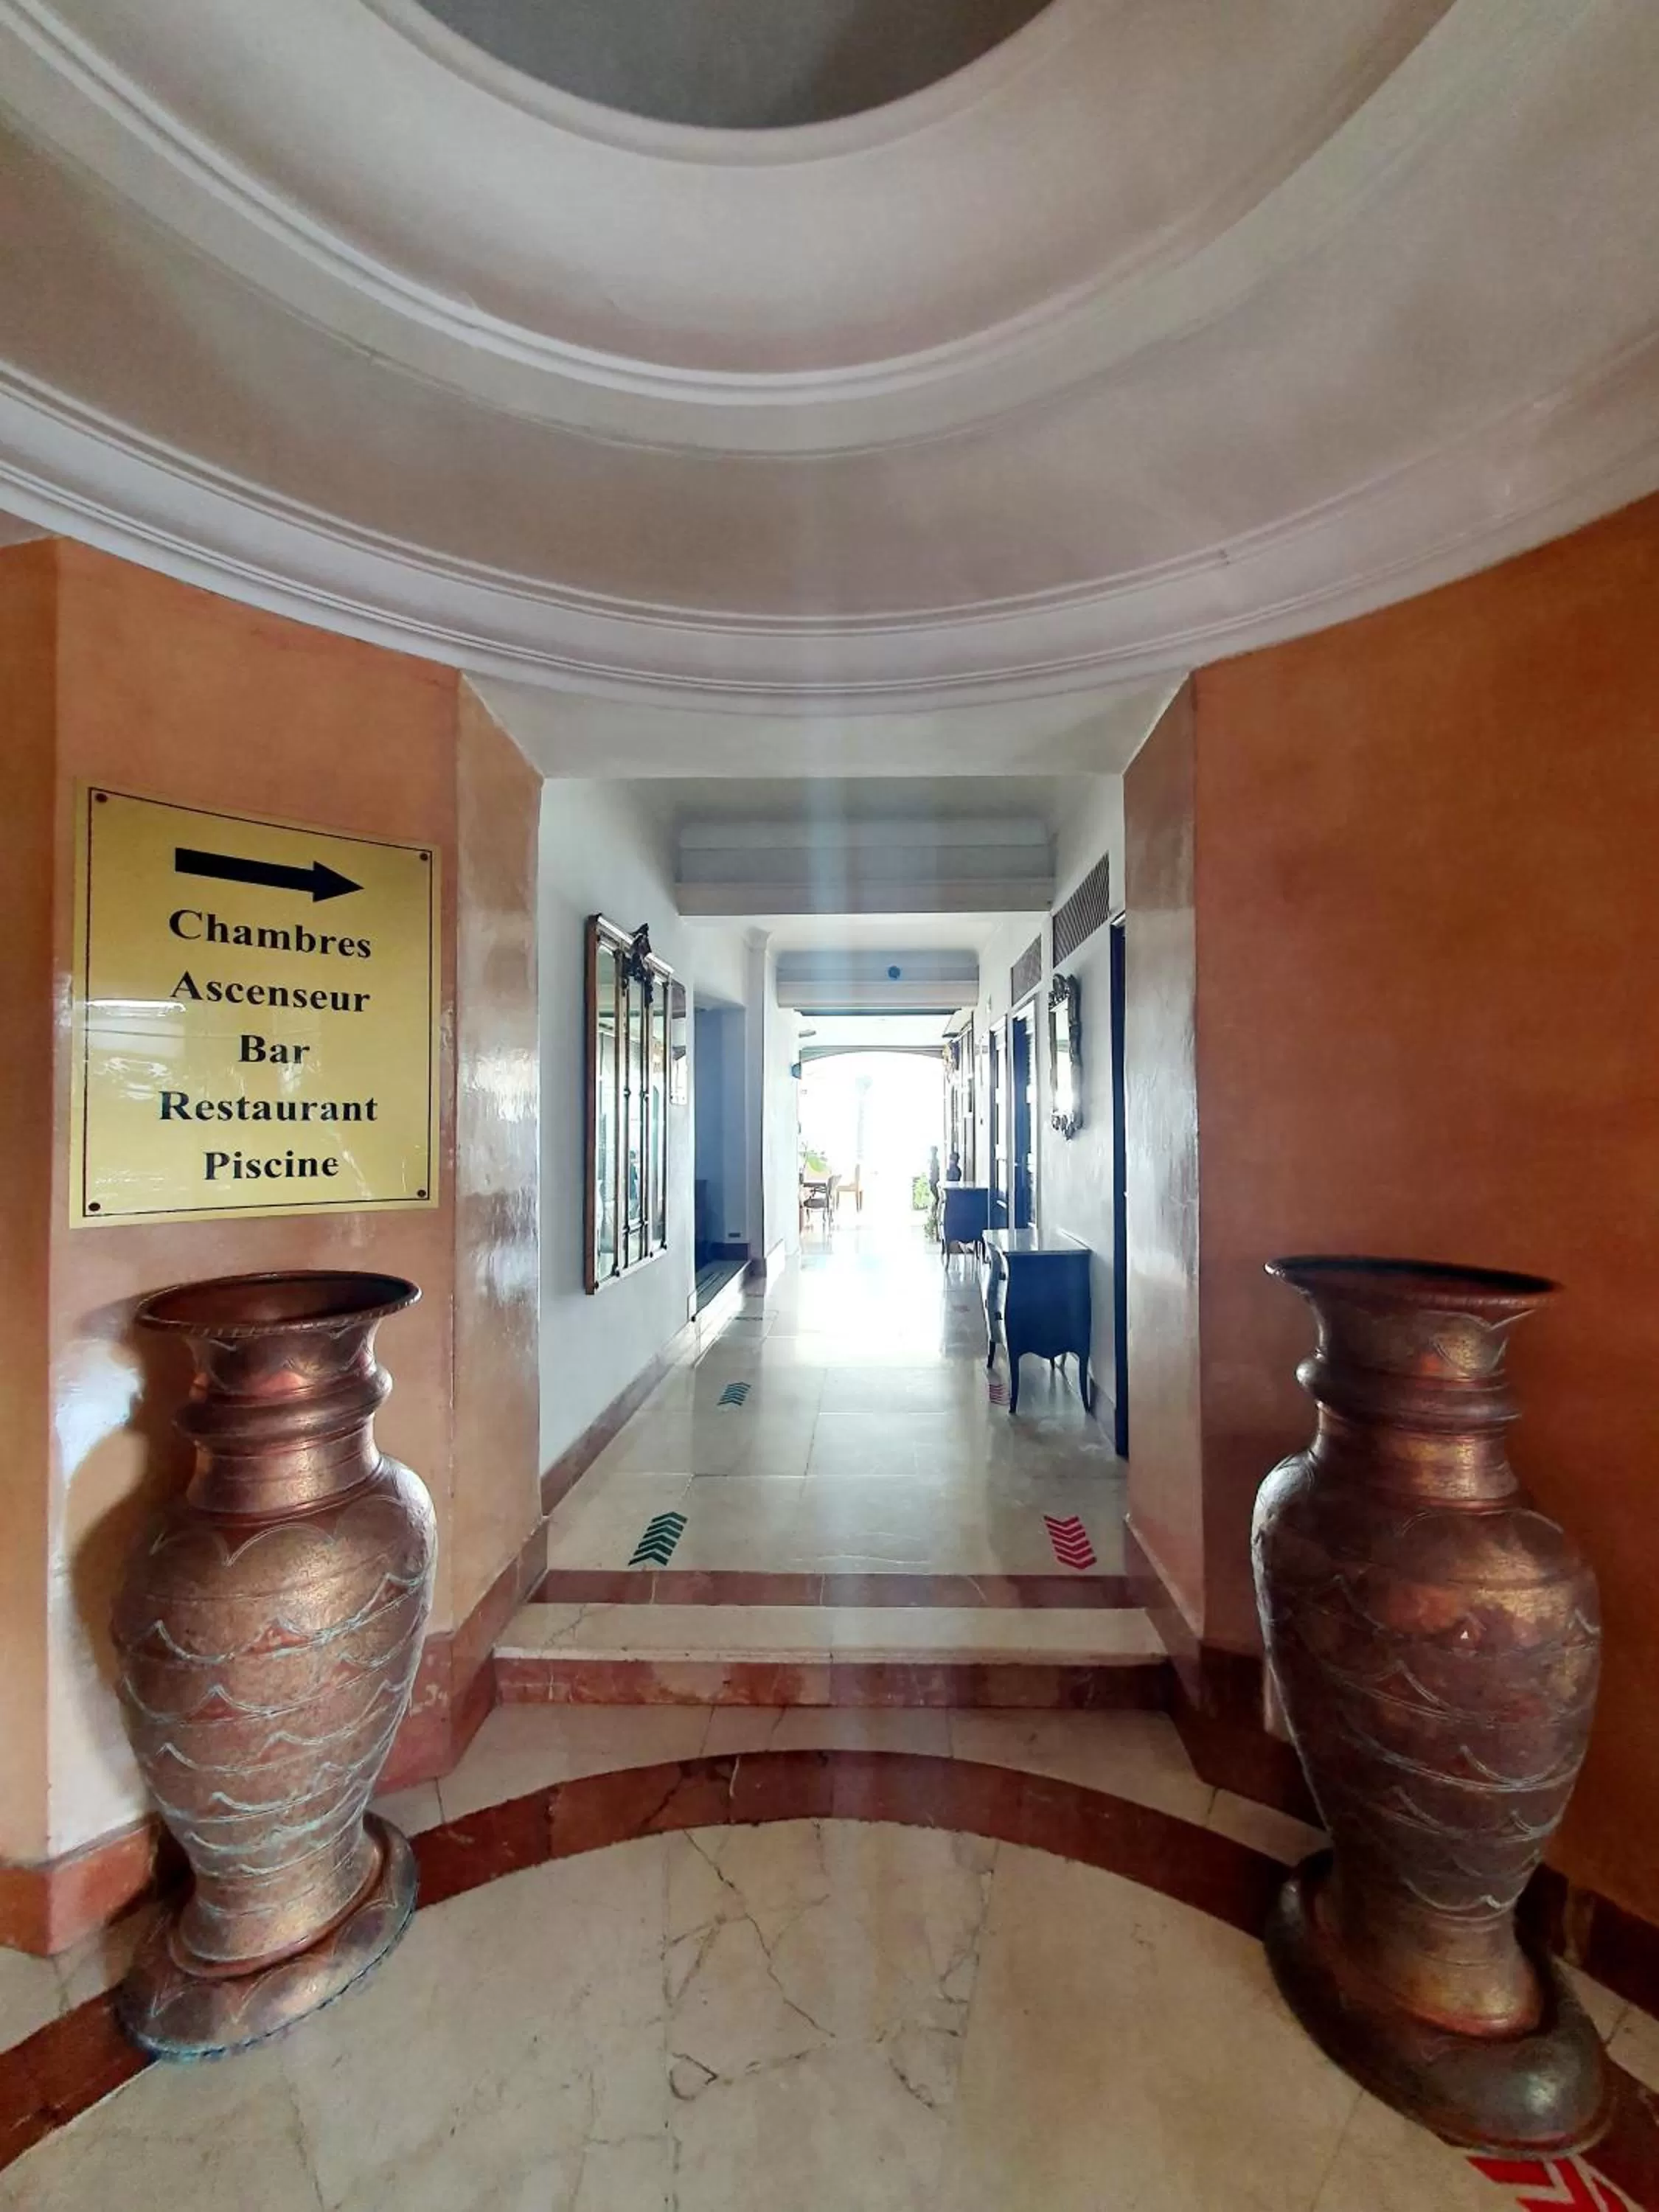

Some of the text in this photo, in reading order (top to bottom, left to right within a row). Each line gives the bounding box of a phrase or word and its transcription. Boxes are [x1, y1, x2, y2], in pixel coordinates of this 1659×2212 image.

[169, 909, 372, 959] Chambres
[170, 971, 371, 1013] Ascenseur
[238, 1034, 310, 1065] Bar
[159, 1091, 378, 1122] Restaurant
[204, 1150, 339, 1181] Piscine
